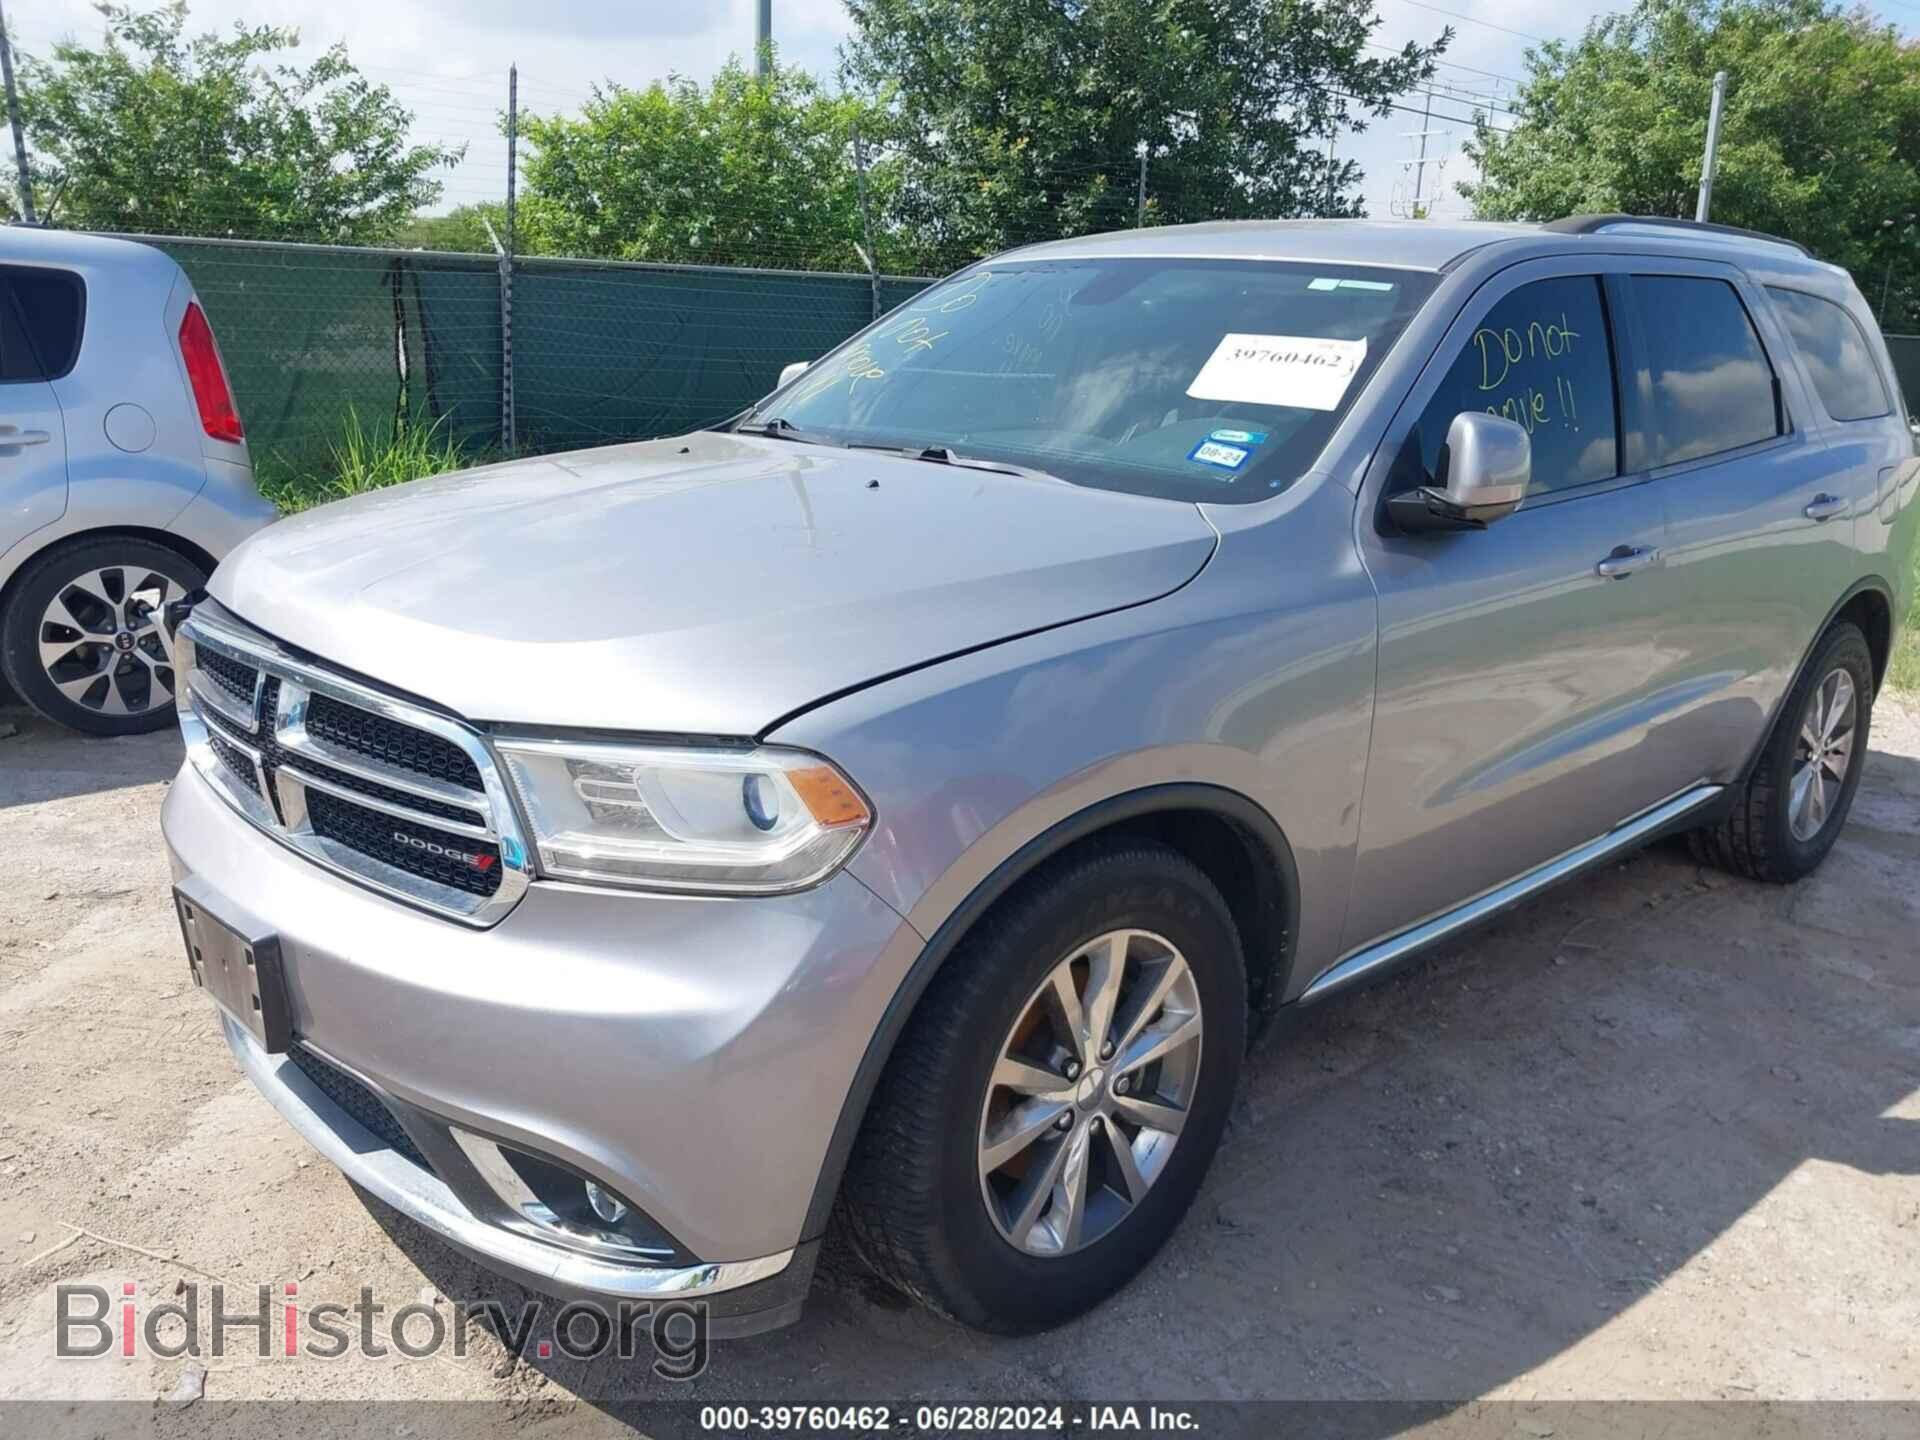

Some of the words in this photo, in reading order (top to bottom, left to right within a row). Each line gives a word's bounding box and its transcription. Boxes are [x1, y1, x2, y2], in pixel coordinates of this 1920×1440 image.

[1226, 348, 1343, 367] 39760462
[1486, 387, 1551, 434] ove
[394, 832, 480, 865] DODGE
